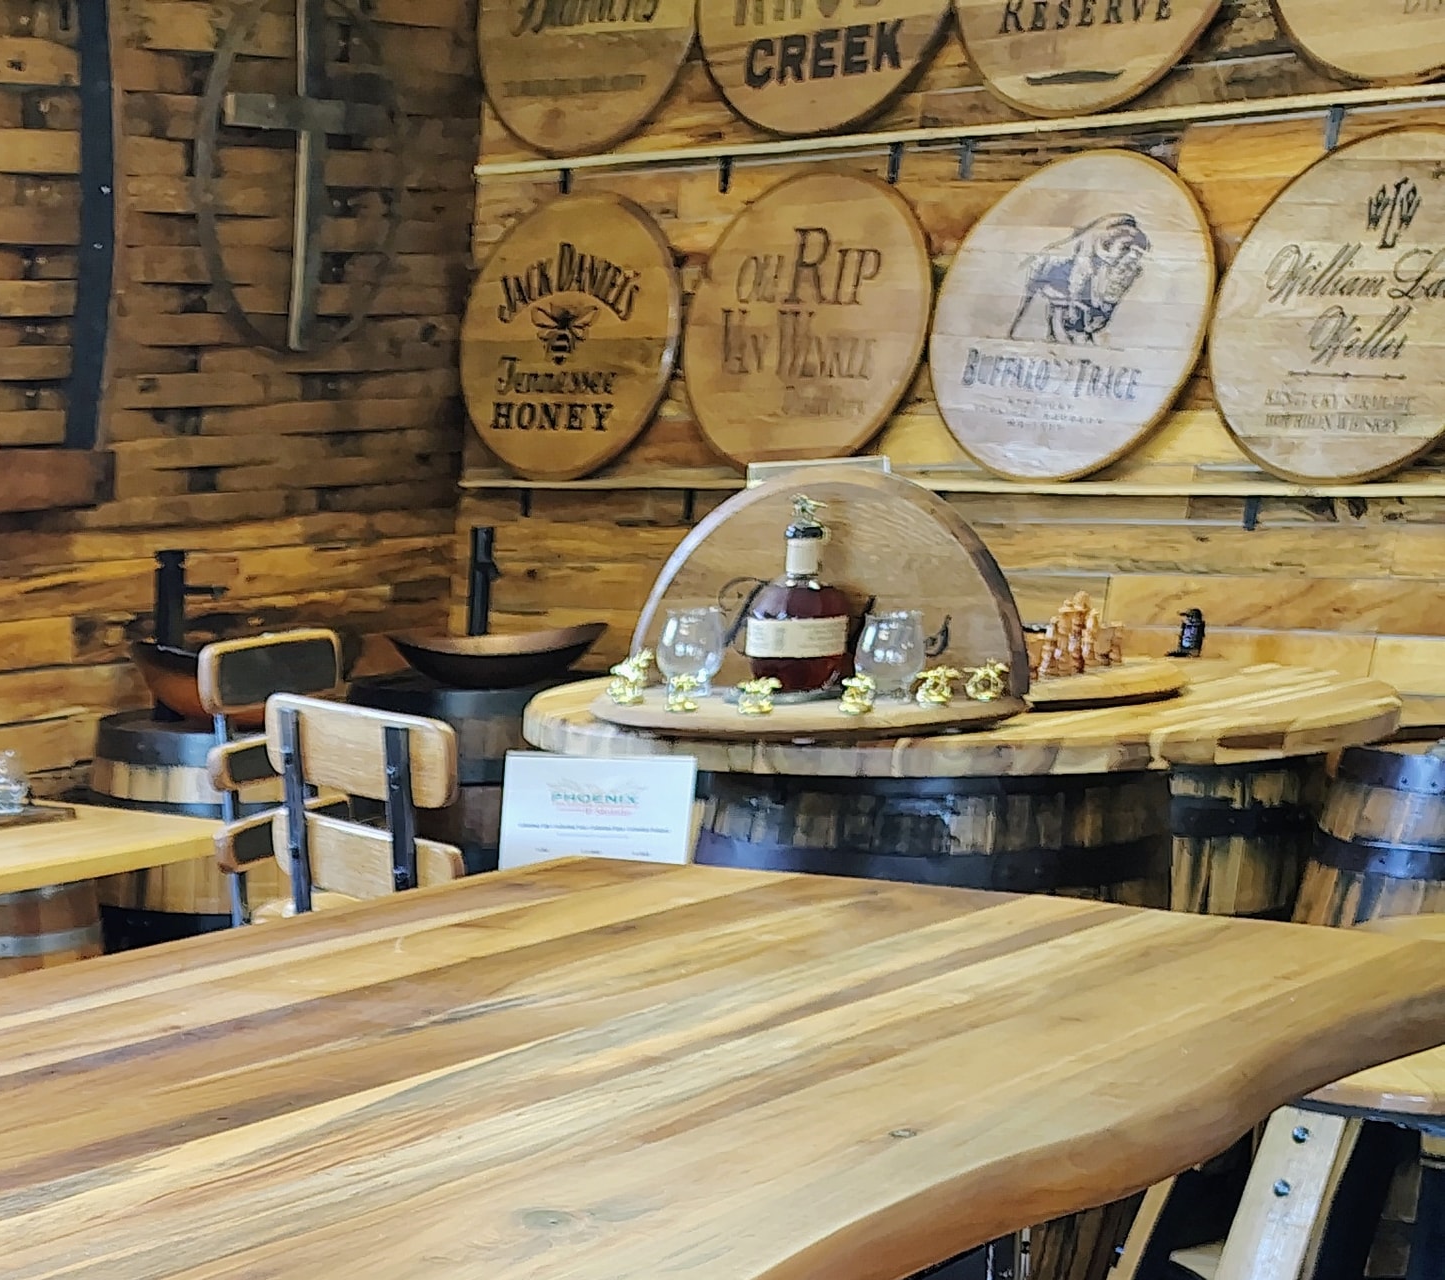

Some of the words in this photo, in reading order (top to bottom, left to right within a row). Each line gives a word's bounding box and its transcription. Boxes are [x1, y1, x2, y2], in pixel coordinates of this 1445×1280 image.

[744, 19, 903, 90] CREEK
[497, 257, 553, 323] JACK
[780, 226, 882, 306] RIP
[1265, 243, 1387, 305] William
[961, 348, 1050, 392] BUFFALO
[1072, 358, 1142, 400] TRACE
[490, 401, 614, 432] HONEY
[551, 791, 639, 805] PHOENIX
